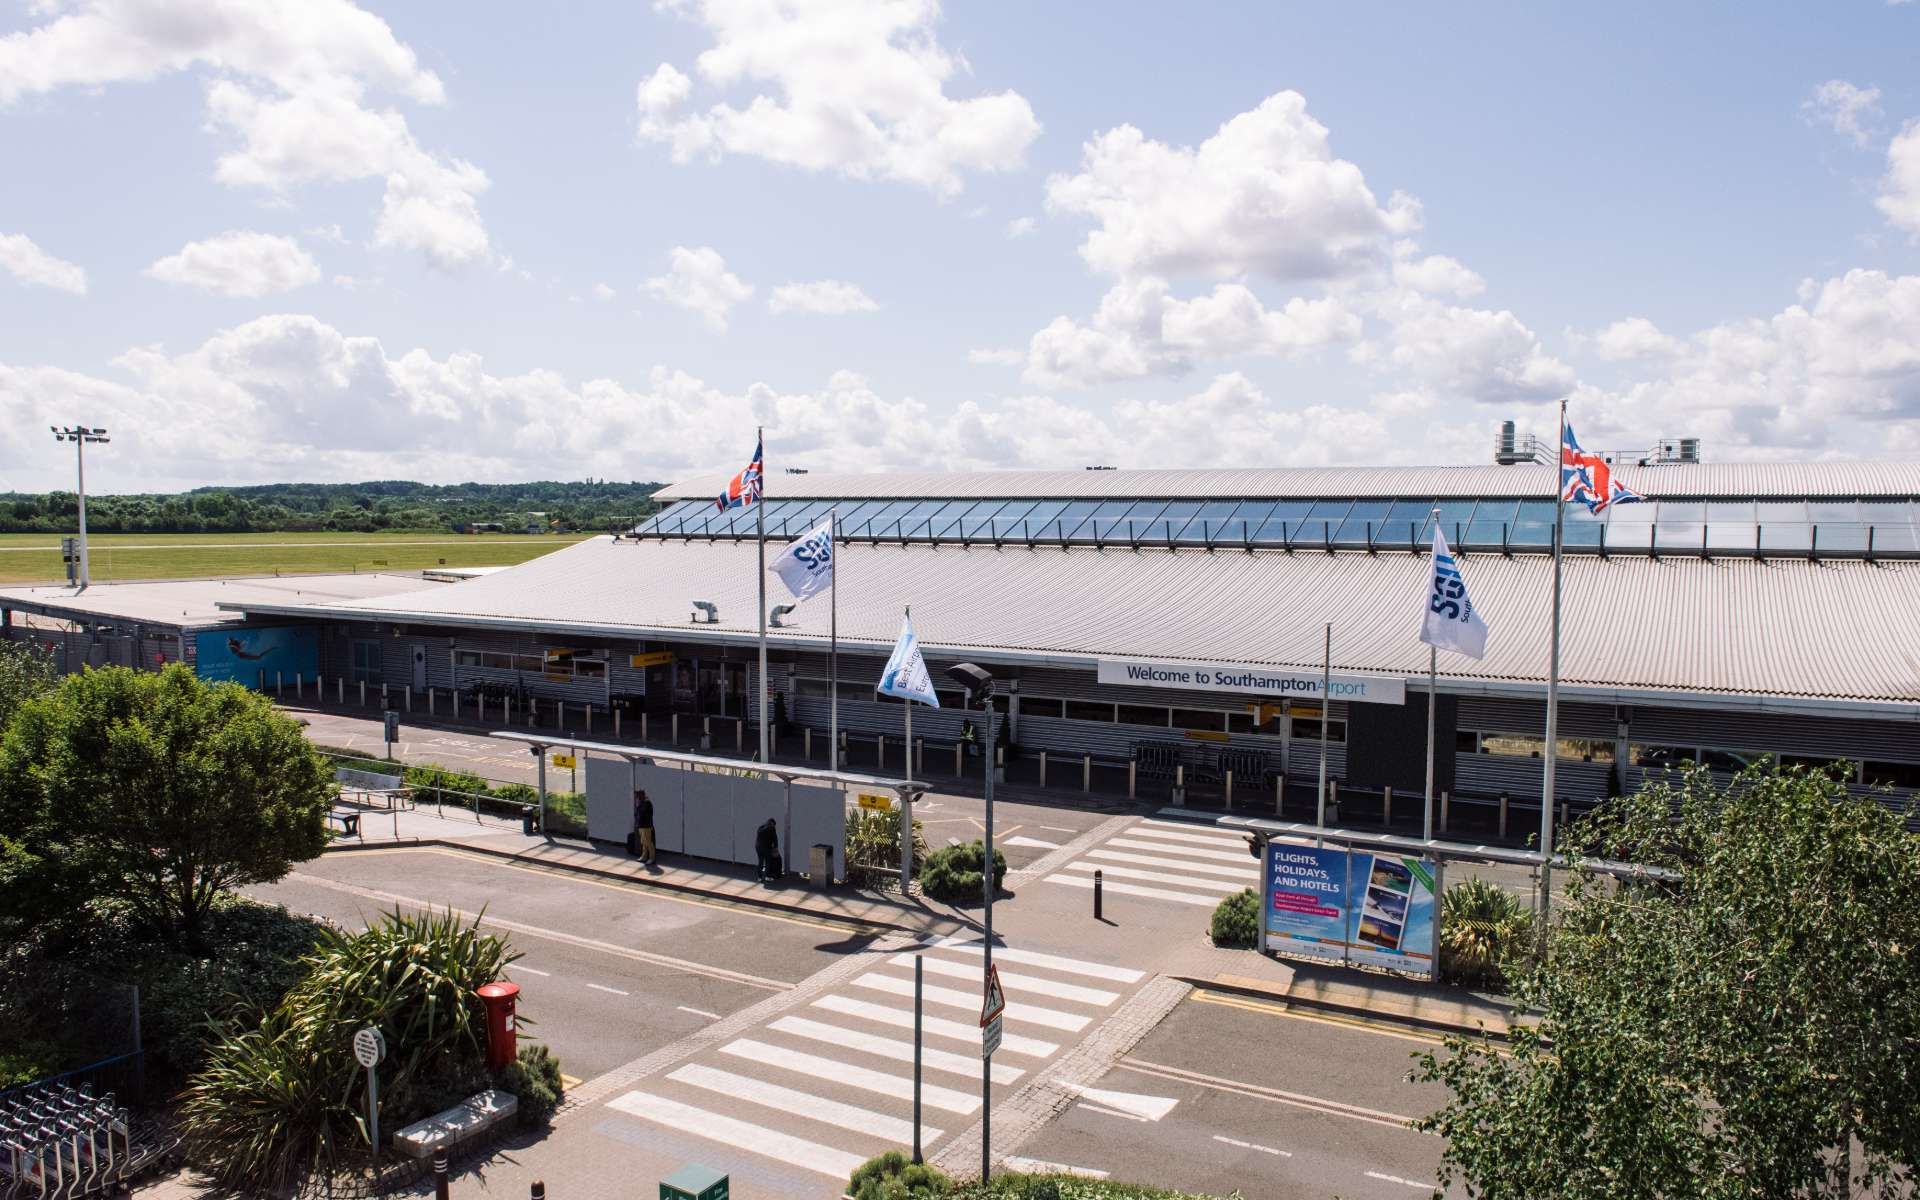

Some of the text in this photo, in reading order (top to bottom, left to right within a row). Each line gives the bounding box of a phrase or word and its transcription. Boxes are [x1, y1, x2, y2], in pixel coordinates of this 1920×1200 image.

[1127, 666, 1190, 683] Welcome
[1195, 671, 1210, 684] to
[1274, 852, 1319, 866] FLIGHTS,
[1274, 864, 1330, 880] HOLIDAYS,
[1274, 876, 1340, 893] AND HOTELS
